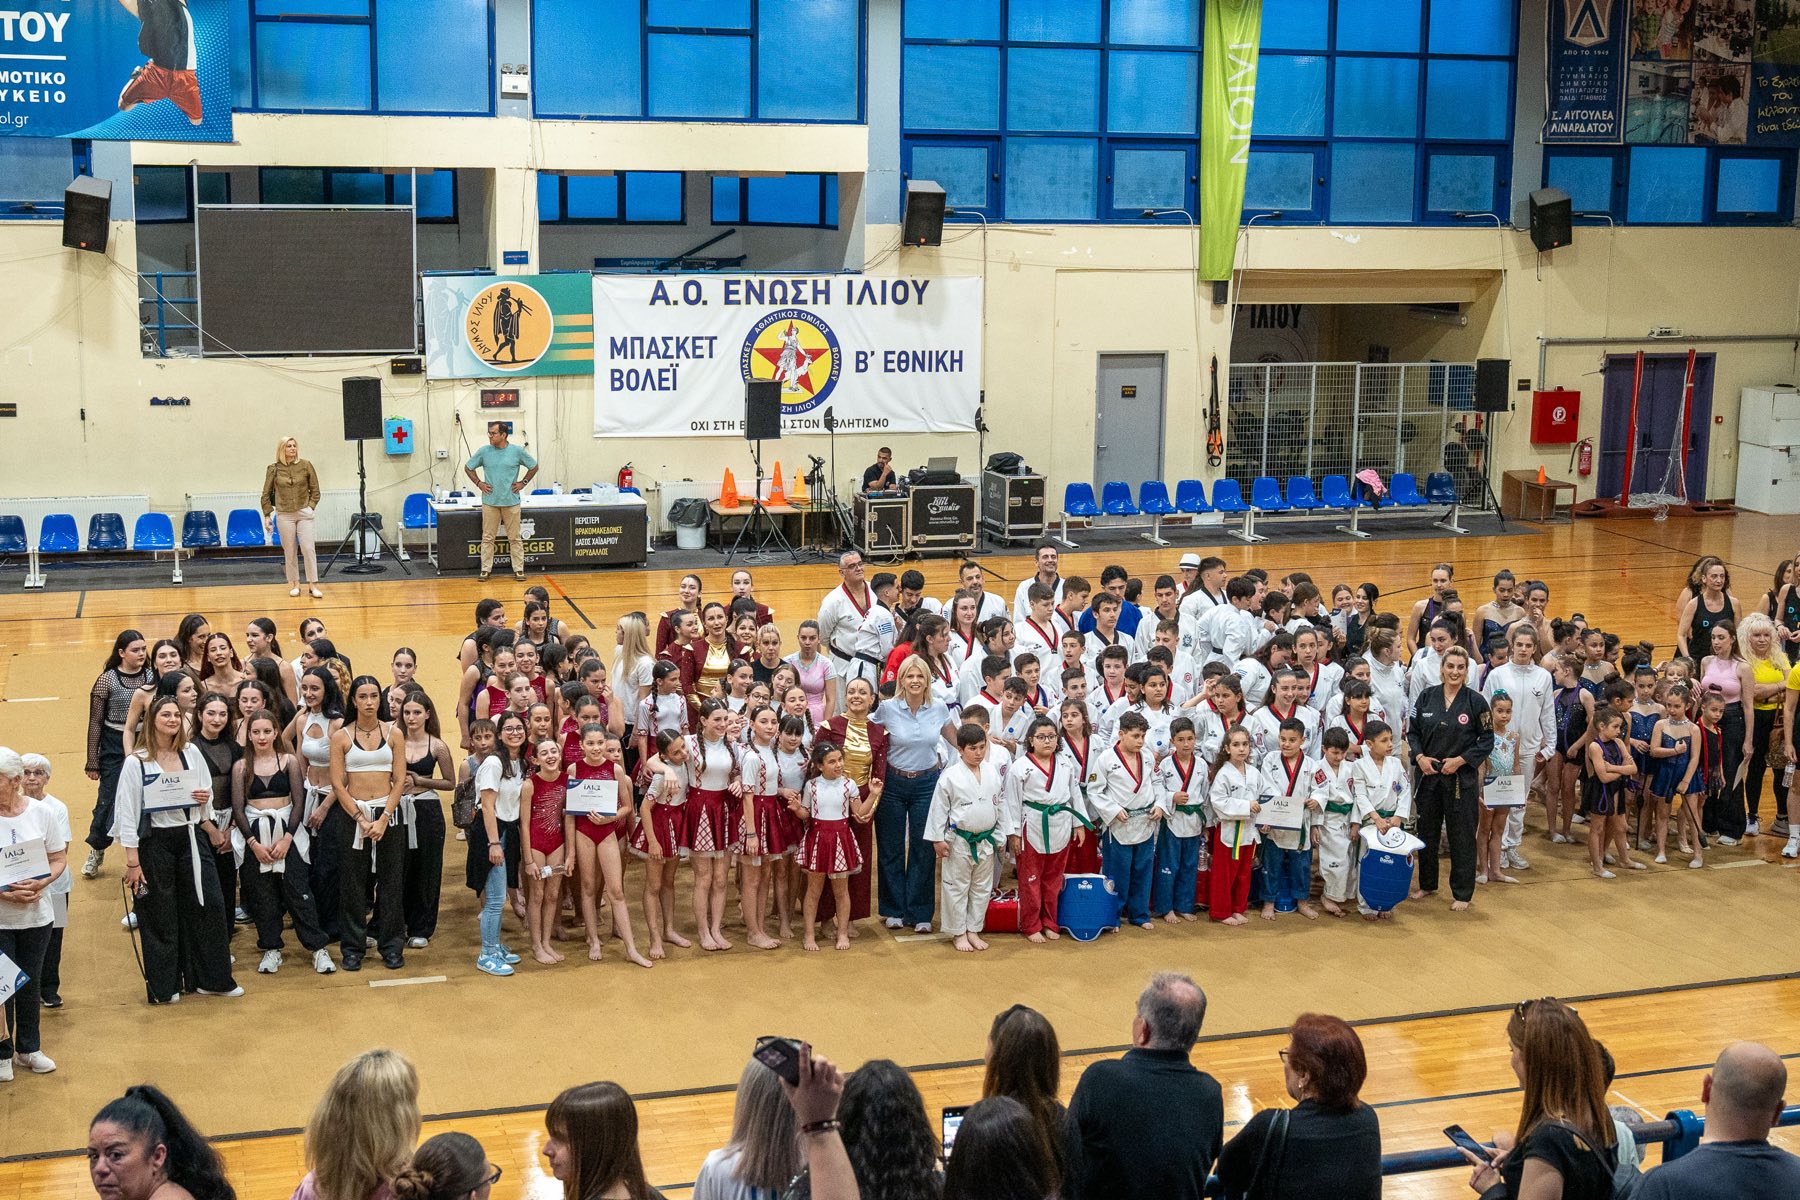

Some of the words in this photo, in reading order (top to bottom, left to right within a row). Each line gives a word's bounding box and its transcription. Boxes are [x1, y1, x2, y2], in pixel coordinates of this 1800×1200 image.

[0, 11, 70, 43] ΤΟΥ
[1228, 42, 1256, 164] ΙΛΙΟΝ
[1551, 111, 1562, 121] Σ.
[1564, 110, 1615, 121] ΑΥΓΟΥΛΕΑ
[1550, 123, 1614, 133] ΛΙΝΑΡΔΑΤΟΥ
[649, 279, 708, 306] Α.Ο.
[723, 279, 831, 306] ΕΝΩΣΗ
[846, 279, 930, 306] ΙΛΙΟΥ
[754, 310, 799, 335] ΑΘΛΗΤΙΚΟΣ
[800, 312, 830, 335] ΟΜΙΛΟΣ
[1250, 303, 1302, 328] ΙΛΙΟΥ
[609, 335, 718, 360] ΜΠΑΣΚΕΤ
[883, 350, 963, 373] ΕΘΝΙΚΗ
[610, 364, 679, 392] ΒΟΛΕΪ
[795, 399, 816, 413] ΙΛΙΟΥ
[690, 421, 709, 431] ΟΧΙ
[713, 420, 736, 431] ΣΤΗ
[790, 419, 820, 429] ΣΤΟΝ
[824, 418, 889, 429] ΘΛΗΤΙΣΜΟ
